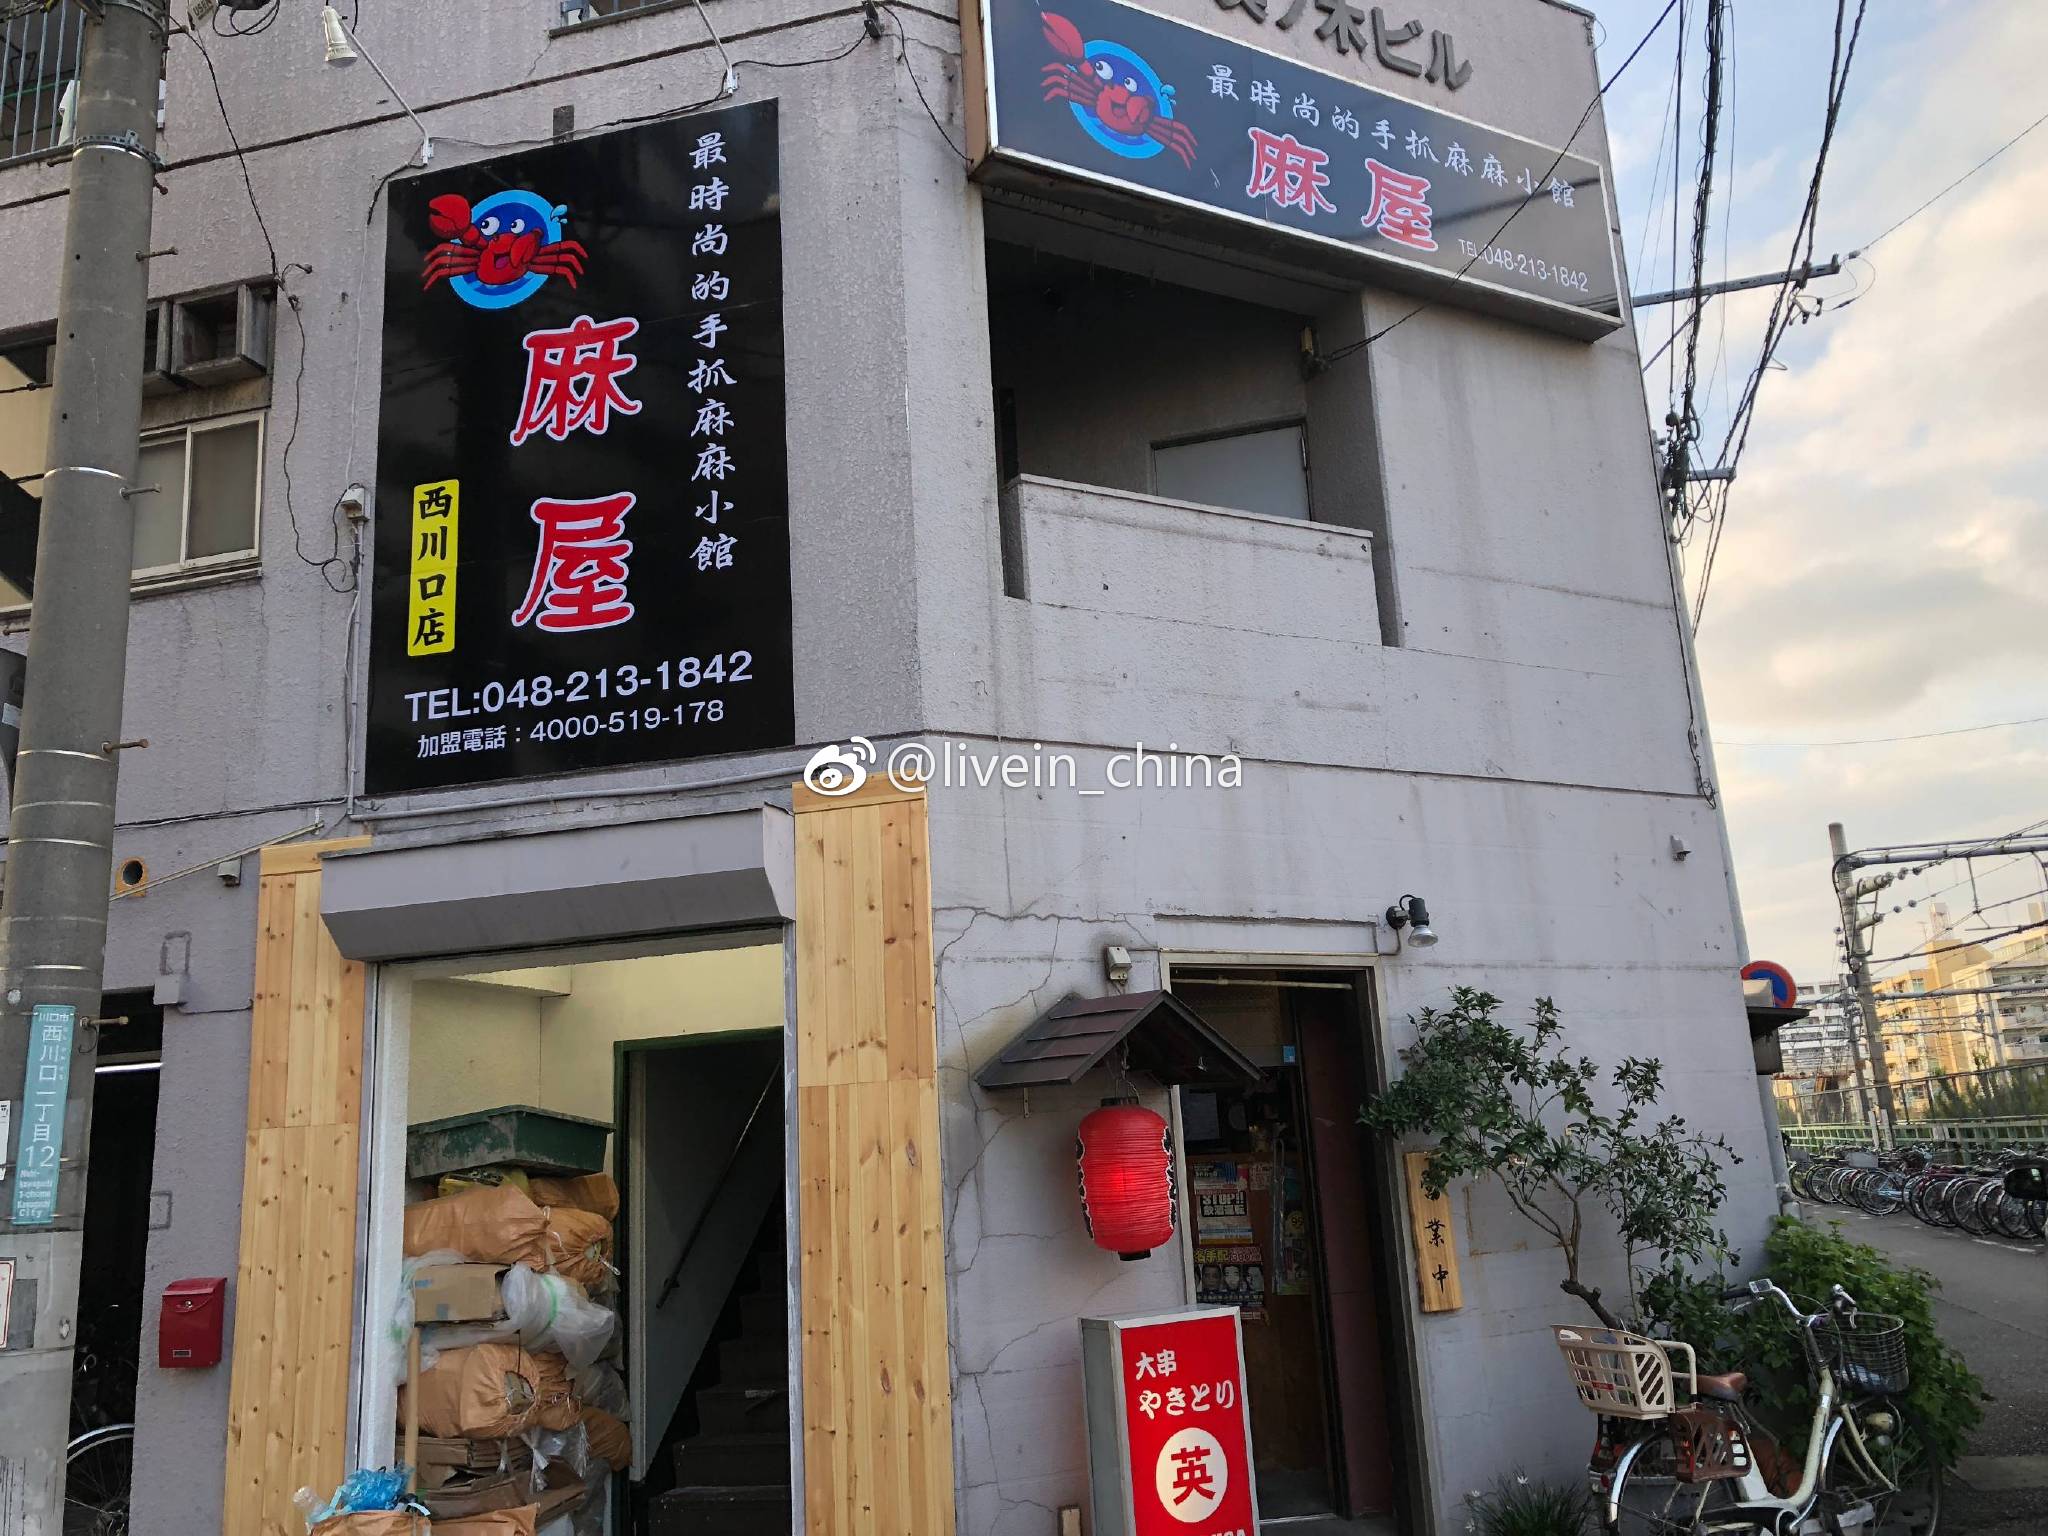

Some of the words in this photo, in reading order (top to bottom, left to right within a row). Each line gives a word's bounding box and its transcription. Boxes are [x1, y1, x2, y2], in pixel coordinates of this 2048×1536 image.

[1204, 63, 1578, 210] 最時尚的手抓麻麻小館
[1247, 126, 1439, 252] 麻屋
[686, 131, 739, 572] 最時尚的手抓麻麻小館
[510, 315, 643, 633] 麻屋
[413, 486, 453, 647] 西川口店
[404, 650, 754, 723] TEL:048-213-1842
[38, 1012, 69, 1022] 川口市
[24, 1145, 55, 1168] 12
[1134, 1349, 1177, 1380] 大串
[1139, 1379, 1236, 1420] やきとり
[1171, 1445, 1217, 1506] 英
